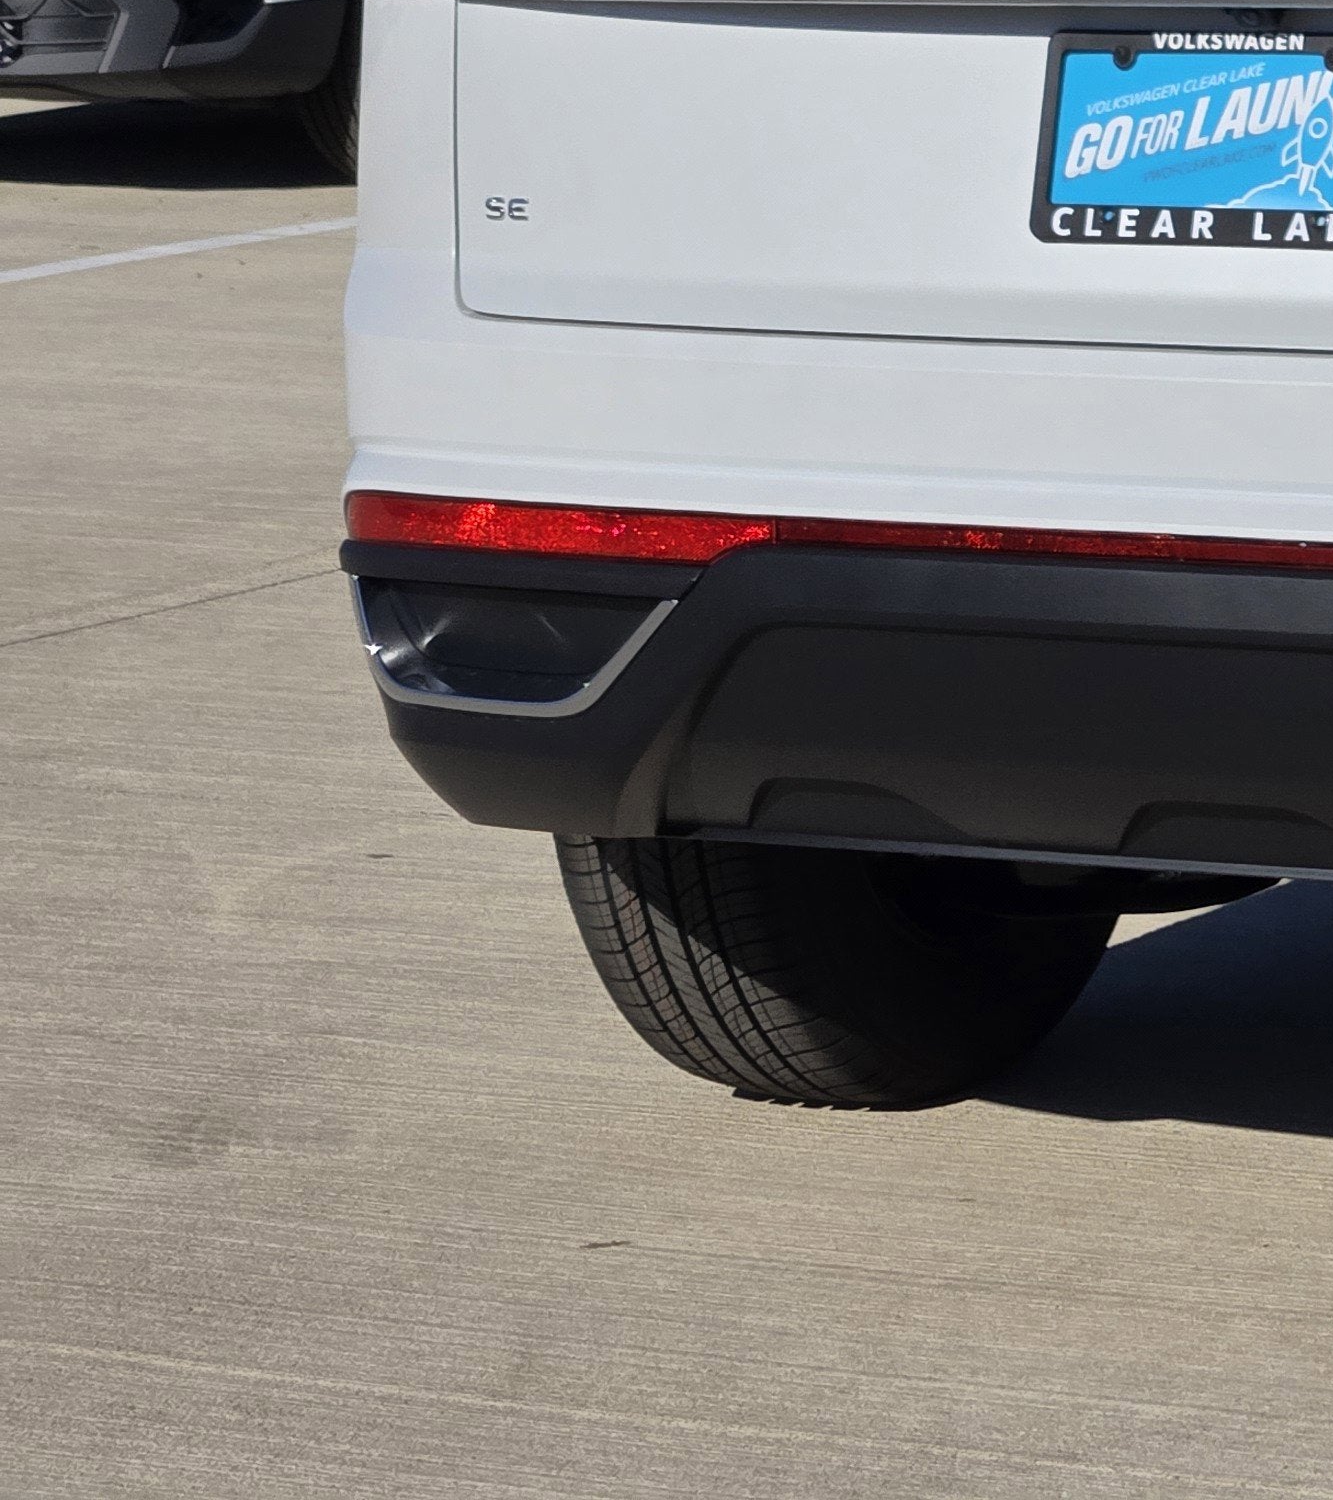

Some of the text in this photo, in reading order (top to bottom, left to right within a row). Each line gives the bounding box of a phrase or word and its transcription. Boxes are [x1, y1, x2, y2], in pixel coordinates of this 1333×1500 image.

[1152, 32, 1304, 51] VOLKSWAGEN
[1087, 61, 1266, 117] VOLKSWAGEN CLEAR LAKE
[1064, 115, 1137, 179] GO
[1130, 110, 1184, 158] FOR
[485, 196, 529, 221] SE
[1051, 206, 1214, 239] CLEAR
